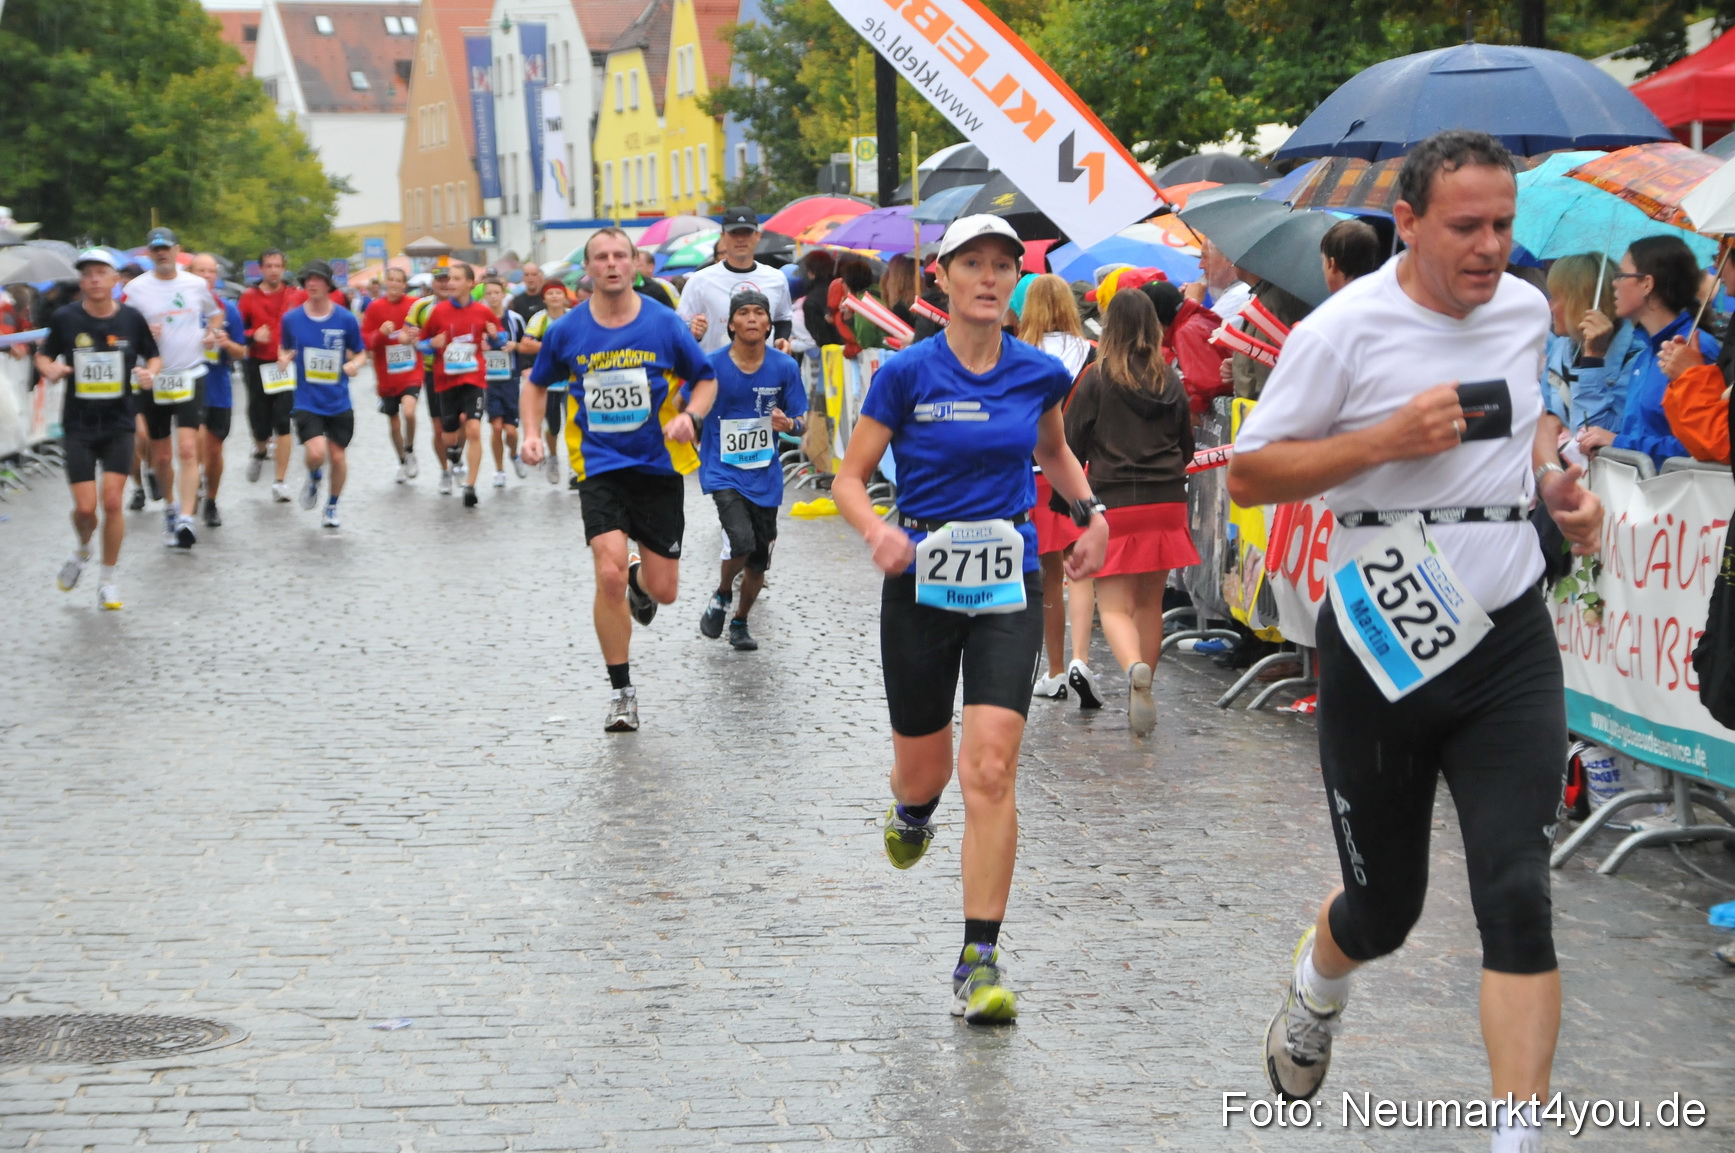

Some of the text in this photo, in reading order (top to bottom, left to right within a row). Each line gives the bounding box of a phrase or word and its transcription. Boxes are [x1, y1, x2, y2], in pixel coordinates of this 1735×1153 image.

[590, 348, 657, 362] NEUMARKTER
[82, 364, 113, 381] 404
[158, 376, 184, 390] 284
[591, 386, 643, 410] 2535
[601, 413, 634, 423] Michael
[726, 429, 768, 452] 3079
[928, 546, 1013, 582] 2715
[1631, 513, 1729, 596] LÄUFT
[947, 590, 994, 605] Renate
[1362, 547, 1457, 661] 2523
[1350, 597, 1391, 657] Martin
